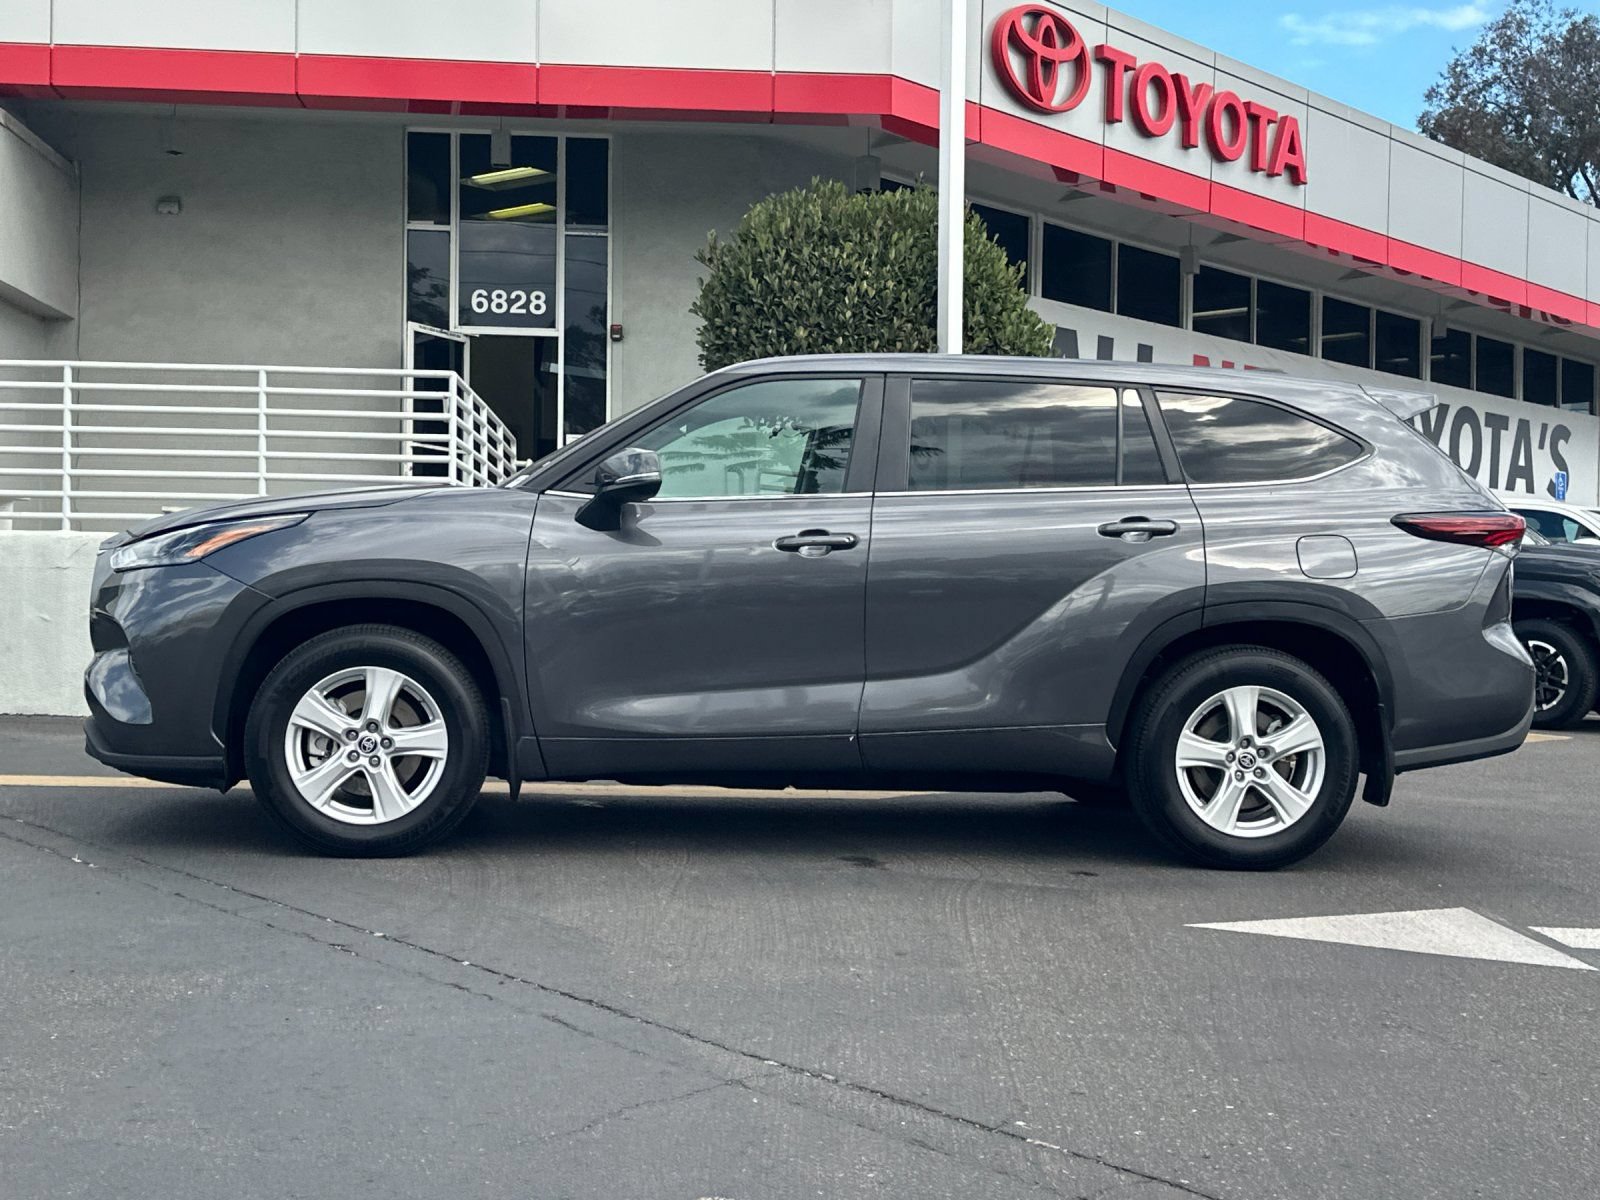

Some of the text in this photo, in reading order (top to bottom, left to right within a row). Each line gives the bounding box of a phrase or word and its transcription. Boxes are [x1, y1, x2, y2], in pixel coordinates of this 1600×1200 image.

[1095, 44, 1308, 186] TOYOTA
[471, 289, 547, 315] 6828
[1404, 402, 1572, 499] YOTA'S
